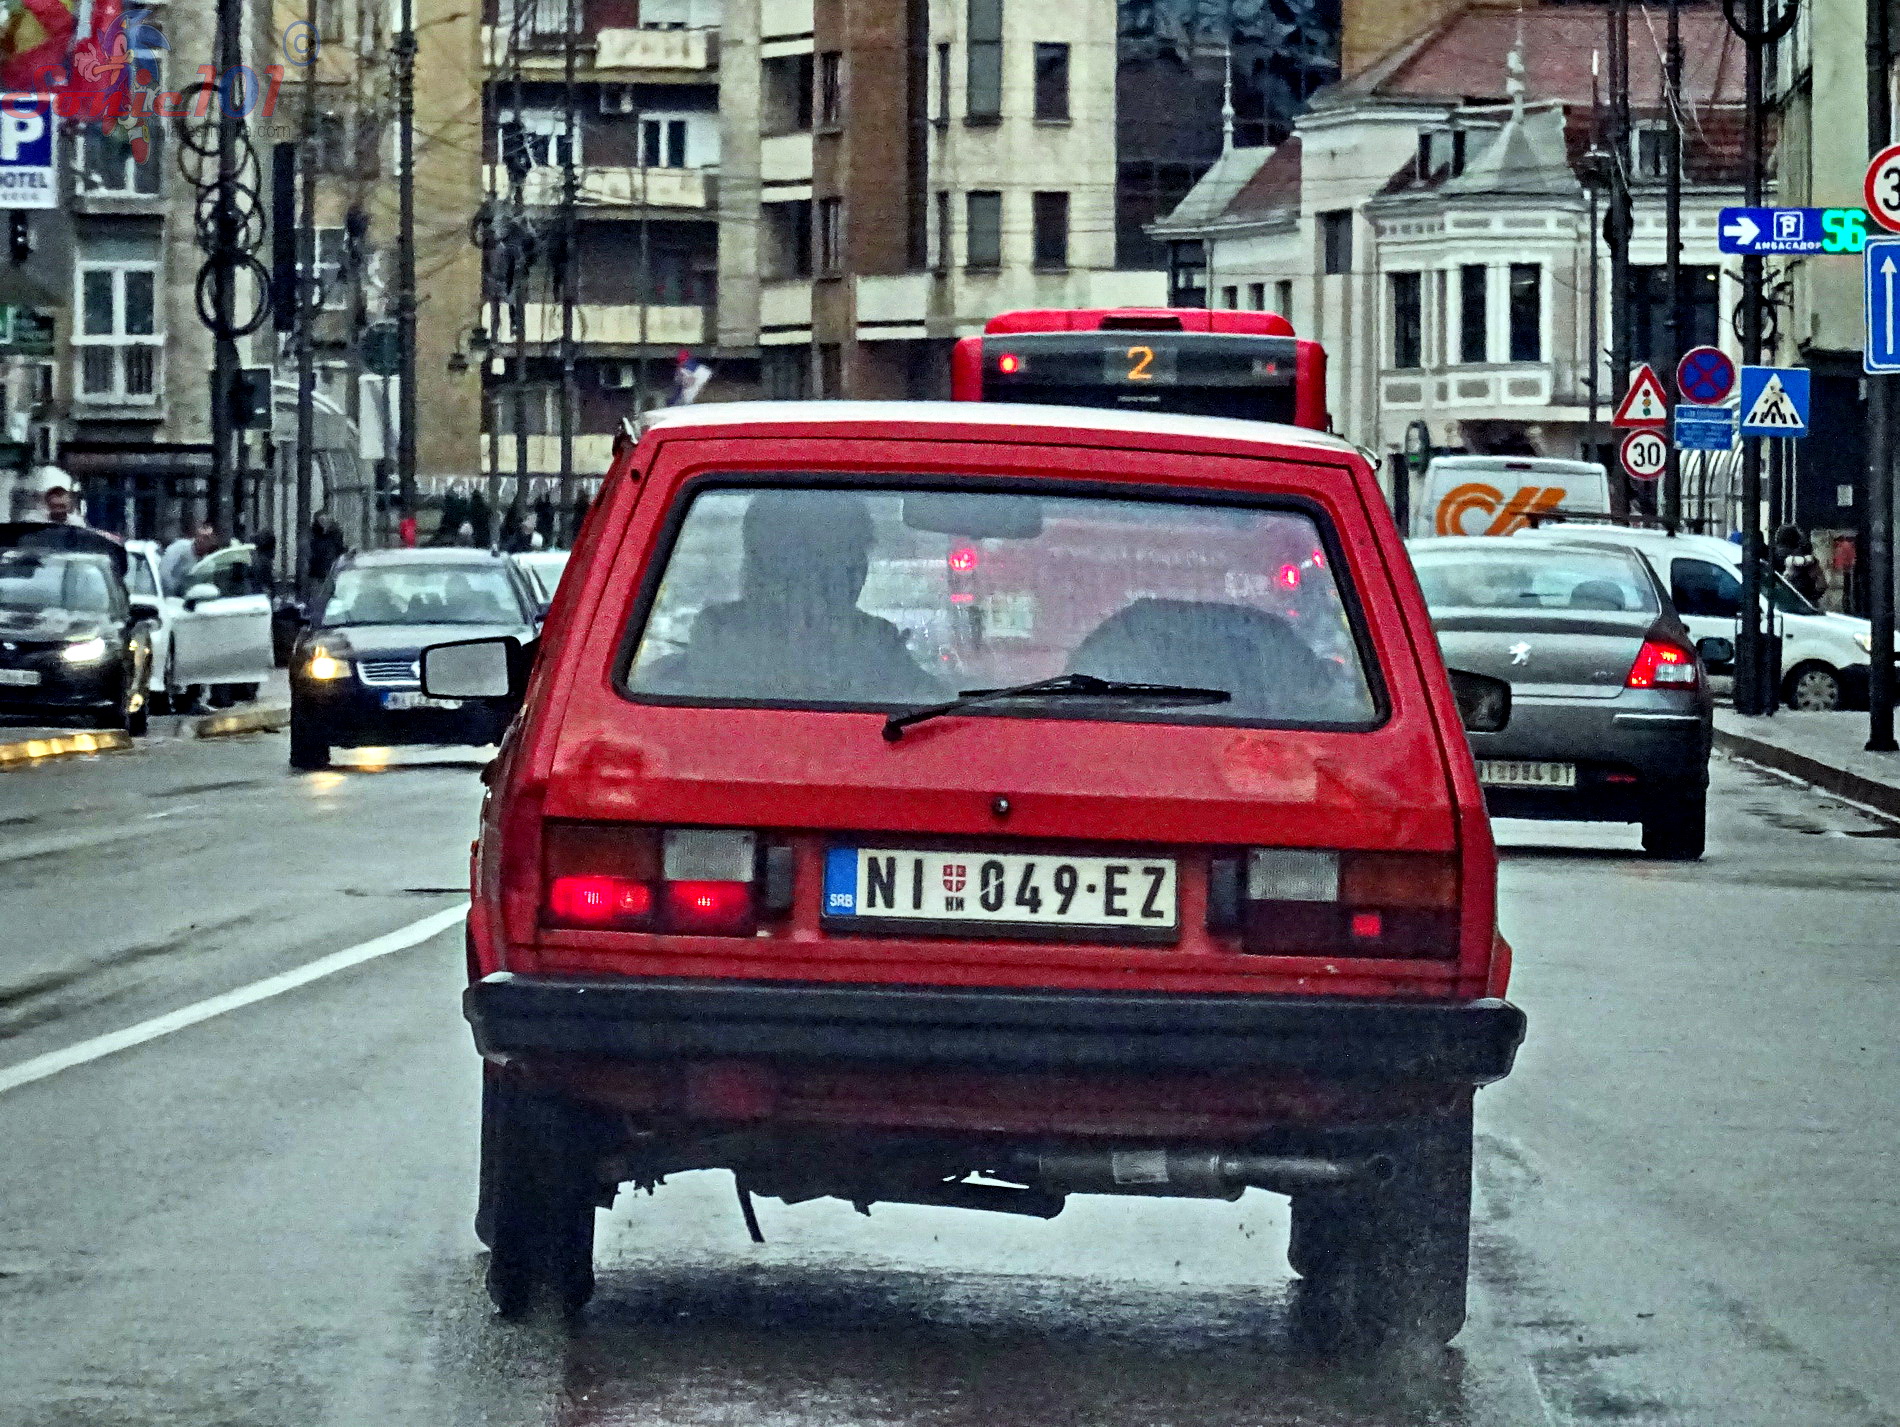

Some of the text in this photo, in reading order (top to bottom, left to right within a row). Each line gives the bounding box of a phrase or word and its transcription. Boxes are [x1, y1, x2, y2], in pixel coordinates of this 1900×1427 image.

[1, 109, 44, 160] P
[1126, 345, 1155, 380] 2
[1632, 441, 1661, 468] 30
[829, 893, 854, 908] SRB
[866, 856, 925, 911] NI
